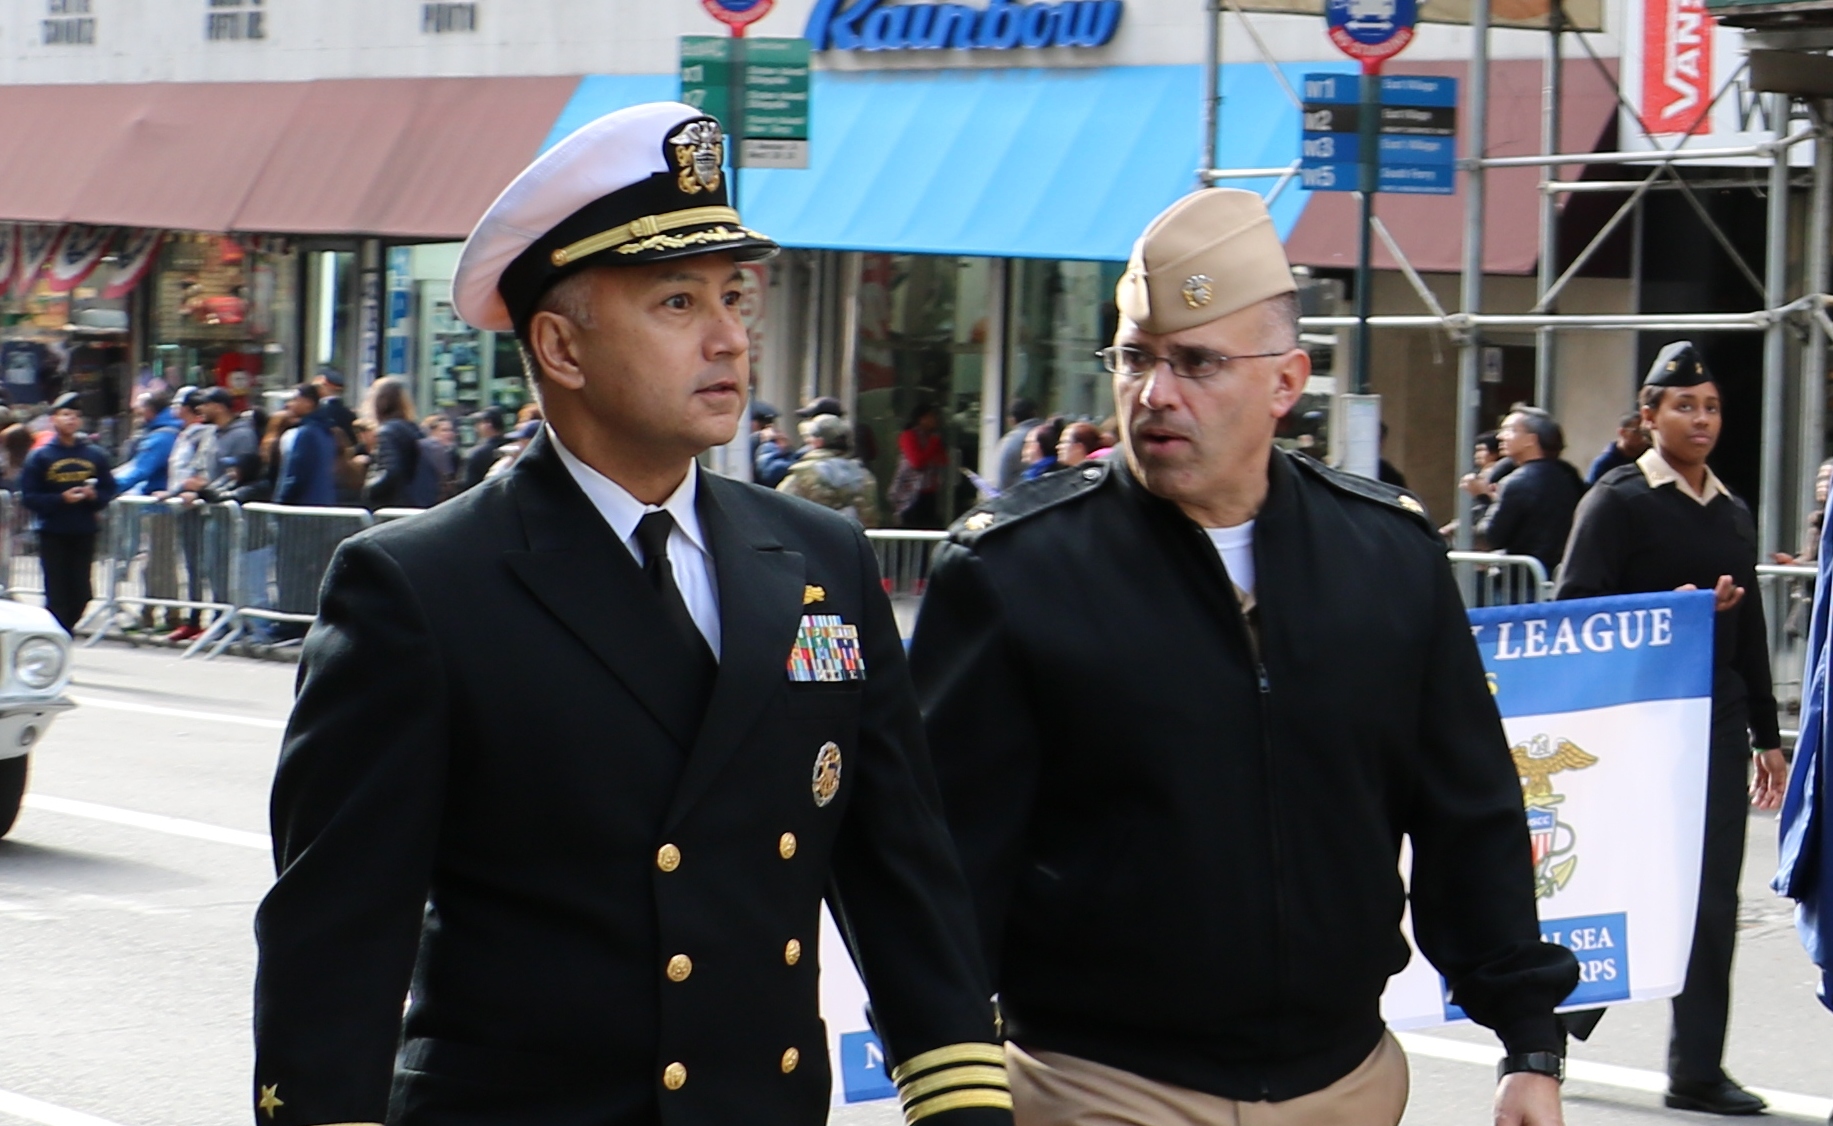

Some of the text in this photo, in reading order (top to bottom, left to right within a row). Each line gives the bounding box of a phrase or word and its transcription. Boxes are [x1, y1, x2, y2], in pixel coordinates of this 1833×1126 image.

[804, 0, 1124, 50] Rainbow
[1494, 608, 1673, 660] LEAGUE
[1570, 927, 1614, 952] SEA
[1579, 958, 1617, 983] RPS
